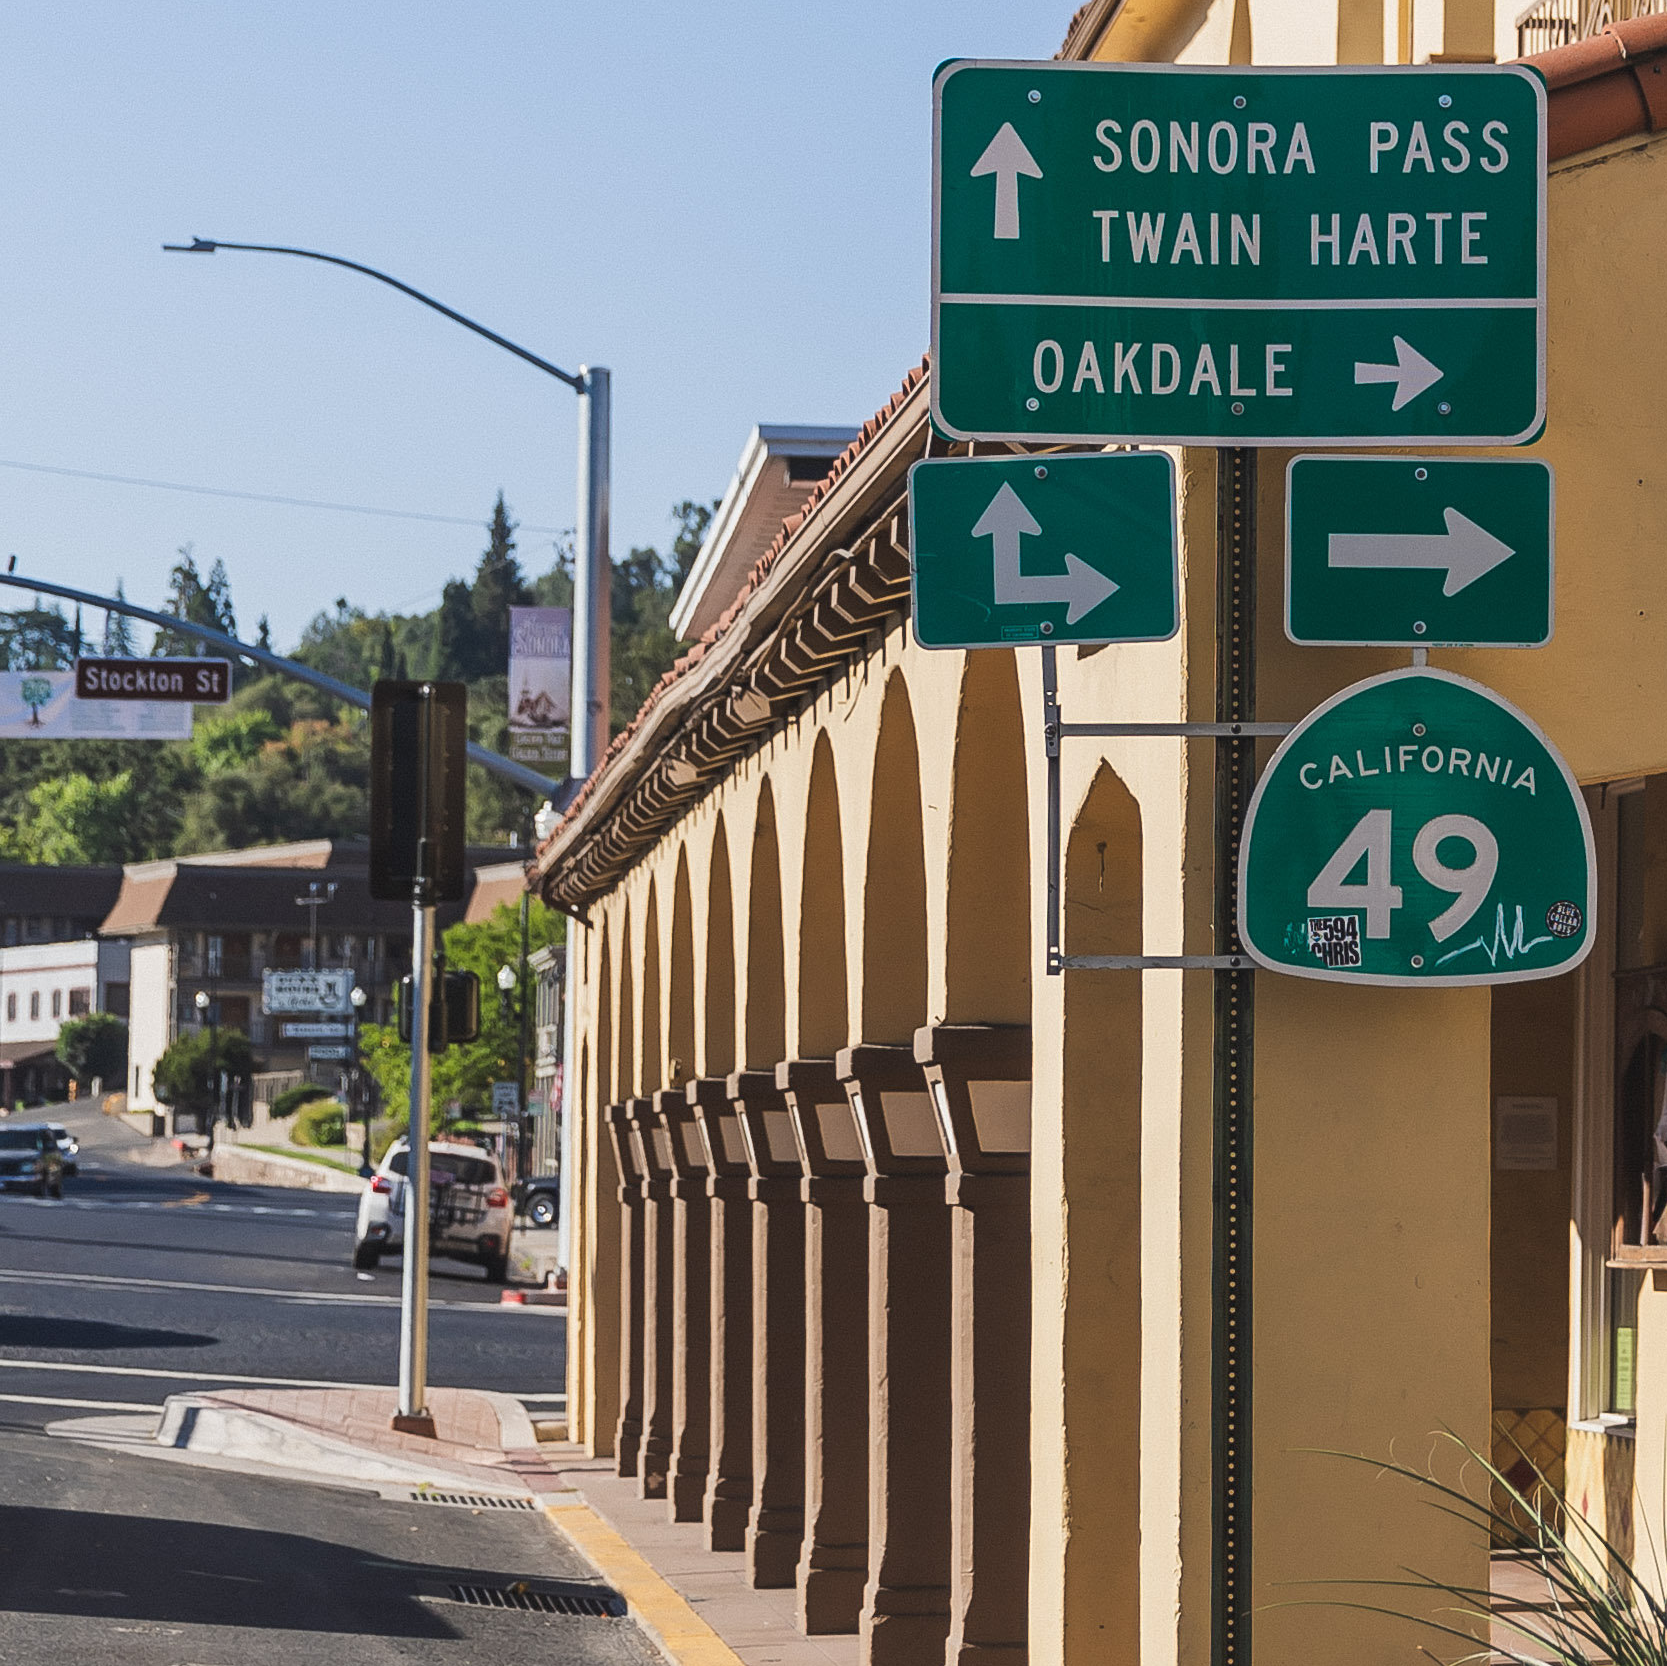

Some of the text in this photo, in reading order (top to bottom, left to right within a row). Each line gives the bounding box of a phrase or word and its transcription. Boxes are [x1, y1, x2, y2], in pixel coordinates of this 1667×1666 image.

[1092, 118, 1510, 175] SONORA PASS
[1092, 209, 1489, 266] TWAIN HARTE
[1032, 339, 1294, 397] OAKDALE
[85, 666, 222, 694] Stockton St
[1299, 745, 1538, 796] CALIFORNIA
[1307, 809, 1500, 944] 49
[1550, 912, 1578, 927] COLLAR
[1557, 905, 1576, 917] BLUE
[1309, 916, 1358, 942] THE 594
[1552, 922, 1572, 935] BOYS
[1311, 940, 1360, 967] CHRIS
